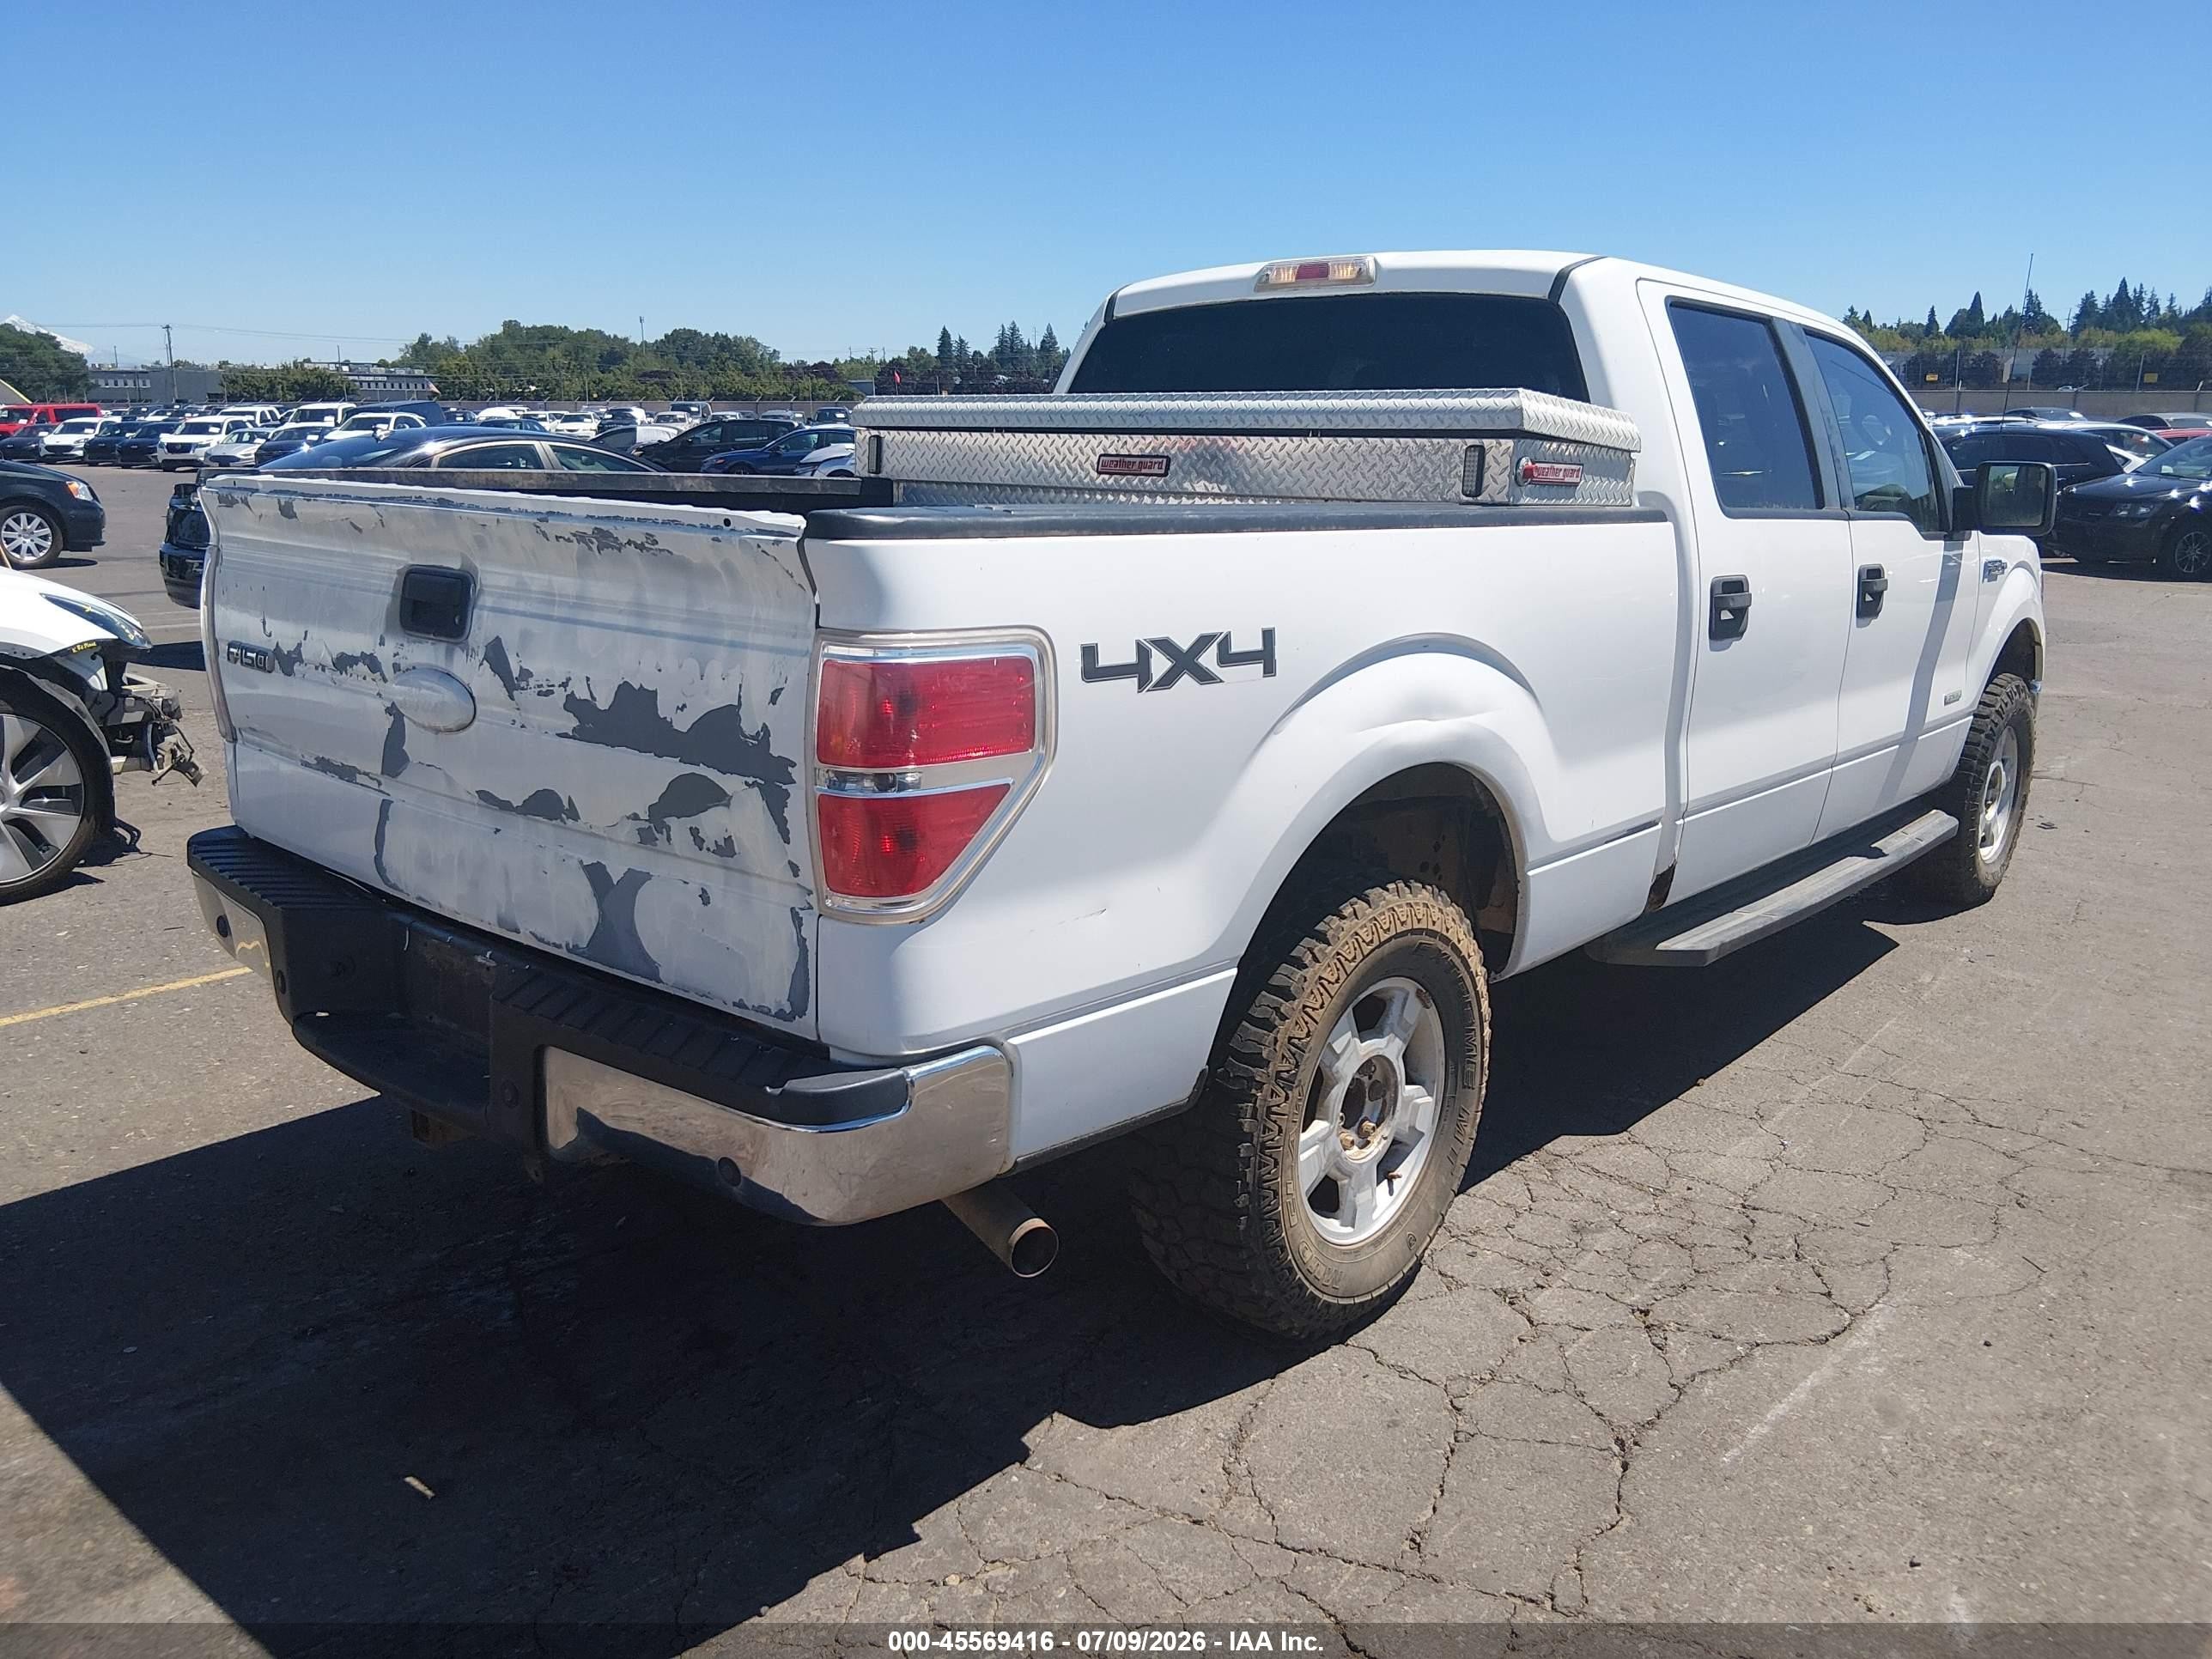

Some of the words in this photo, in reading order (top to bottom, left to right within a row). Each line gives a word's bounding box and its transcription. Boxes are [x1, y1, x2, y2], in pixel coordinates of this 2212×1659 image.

[1100, 458, 1136, 469] weather
[1138, 459, 1164, 471] guard
[1563, 466, 1581, 478] guard
